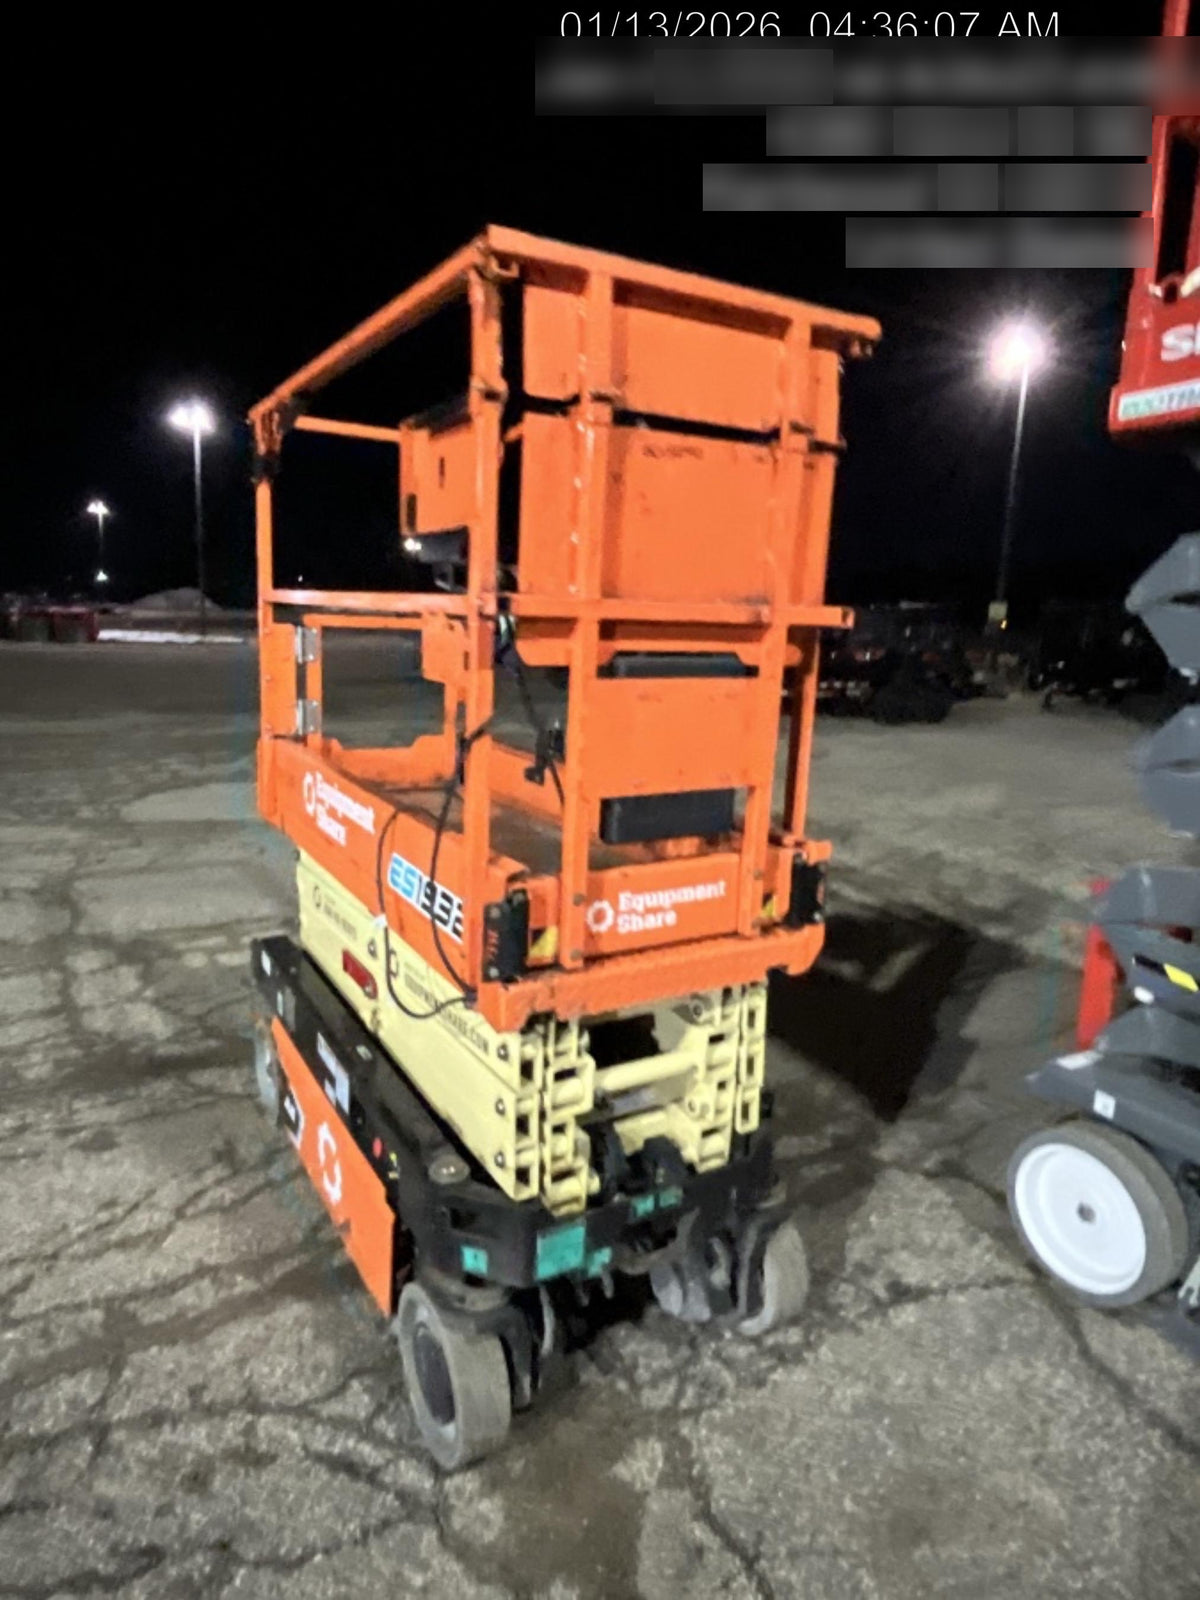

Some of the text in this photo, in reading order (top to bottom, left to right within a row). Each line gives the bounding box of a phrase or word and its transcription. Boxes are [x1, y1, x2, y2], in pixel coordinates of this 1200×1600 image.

[1160, 320, 1200, 362] S
[617, 879, 727, 912] Equipment
[616, 909, 678, 935] Share
